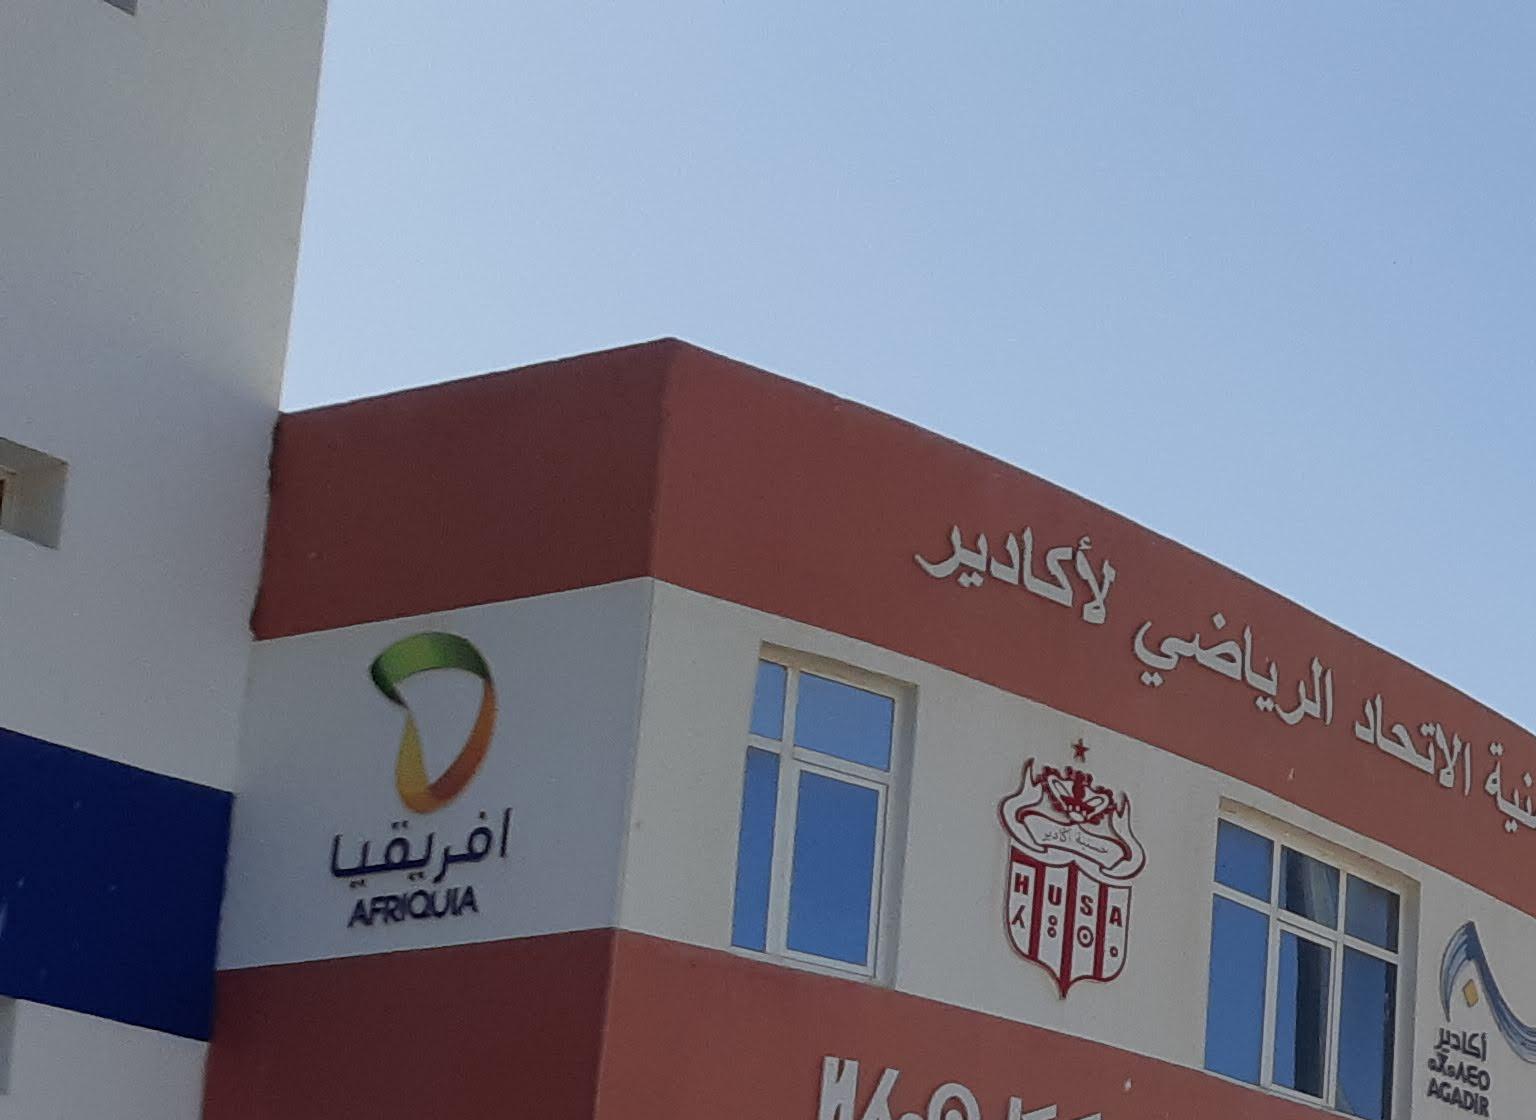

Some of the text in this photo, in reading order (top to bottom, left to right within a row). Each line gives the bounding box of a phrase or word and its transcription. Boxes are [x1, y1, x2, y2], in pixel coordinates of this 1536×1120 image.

[914, 524, 1117, 625] لأكادير
[1133, 613, 1334, 726] الرياضي
[1354, 694, 1472, 797] الاتحاد
[331, 807, 513, 888] افريقيا
[347, 885, 480, 928] AFRIQUIA
[1427, 1077, 1490, 1117] AGADIR
